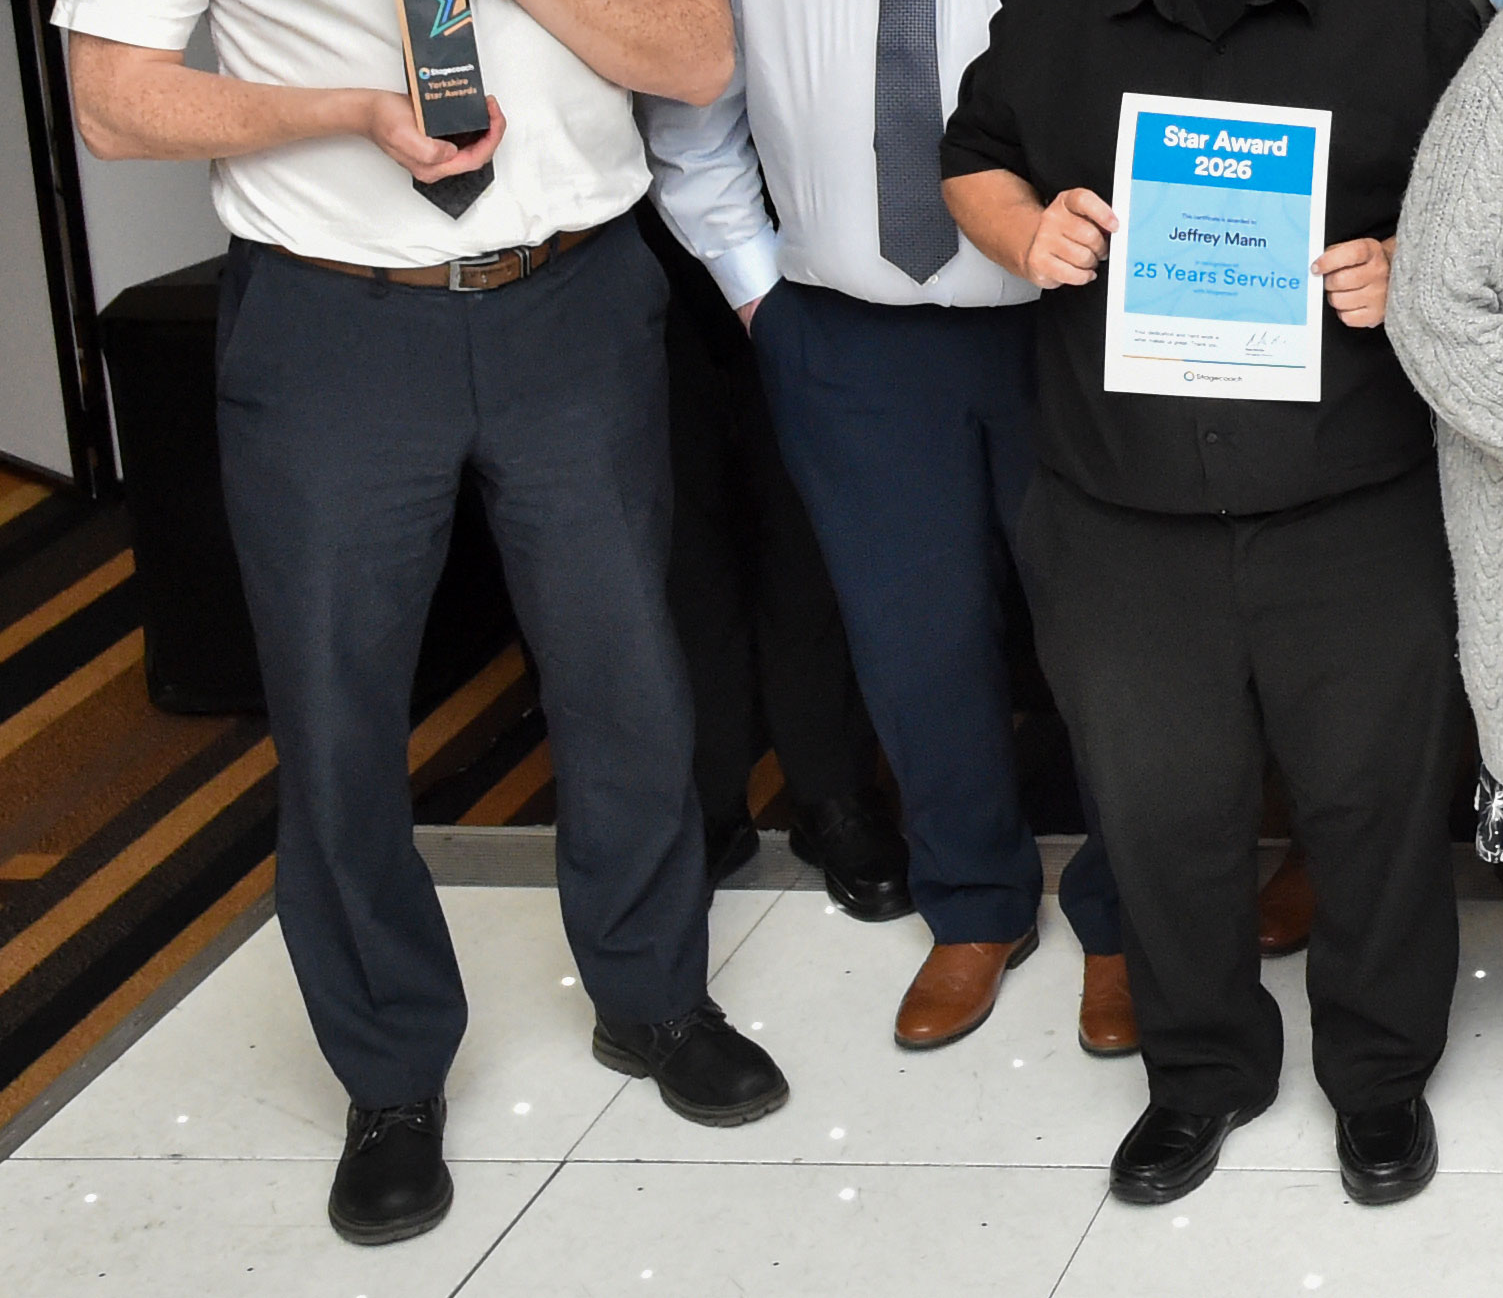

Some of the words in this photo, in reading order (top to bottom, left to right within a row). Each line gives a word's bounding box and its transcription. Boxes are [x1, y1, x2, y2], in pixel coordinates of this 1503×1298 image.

[1163, 125, 1210, 149] Star
[1212, 130, 1288, 157] Award
[1194, 155, 1252, 180] 2026
[1169, 226, 1221, 247] Jeffrey
[1225, 232, 1267, 248] Mann
[1133, 262, 1157, 279] 25
[1164, 263, 1217, 284] Years
[1224, 268, 1300, 290] Service
